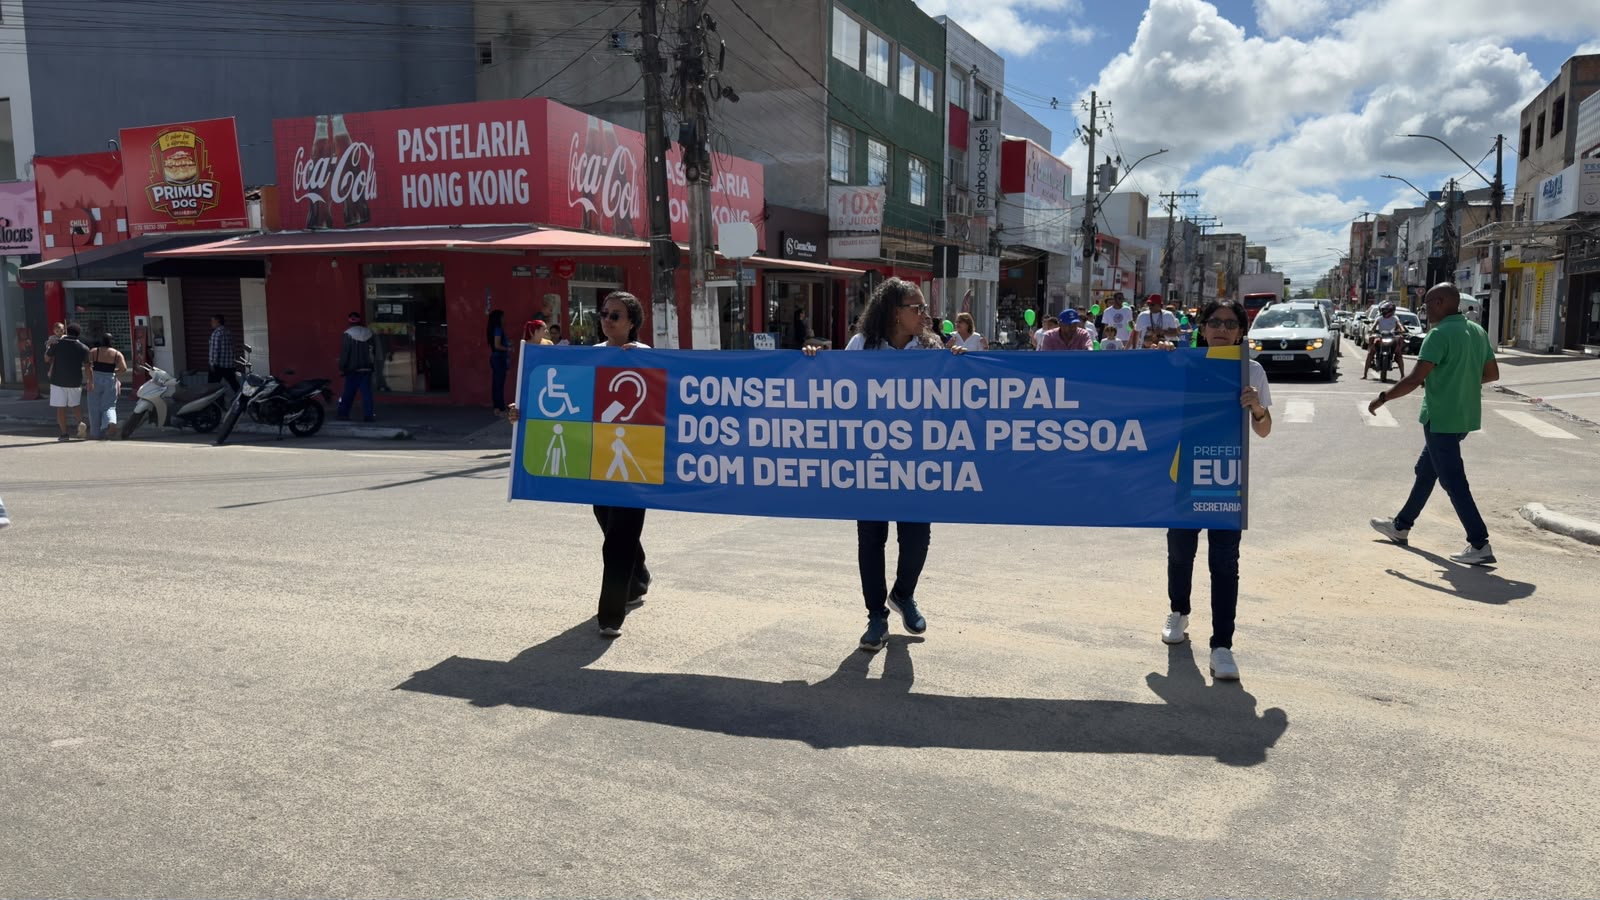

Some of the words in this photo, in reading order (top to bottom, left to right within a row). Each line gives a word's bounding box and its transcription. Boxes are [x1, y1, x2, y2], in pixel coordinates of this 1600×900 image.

[397, 119, 531, 164] PASTELARIA
[292, 141, 378, 204] Coca-Cola
[401, 171, 463, 209] HONG
[467, 168, 530, 207] KONG
[567, 131, 640, 220] Coca-Cola
[665, 160, 751, 199] ASARIA
[152, 181, 214, 203] PRIMUS
[172, 197, 197, 209] DOG
[838, 191, 880, 215] 10X
[69, 219, 89, 227] CHILLI
[848, 215, 879, 226] JUROS
[679, 375, 858, 410] CONSELHO
[867, 377, 1079, 410] MUNICIPAL
[677, 414, 741, 446] DOS
[748, 417, 913, 451] DIREITOS
[922, 419, 976, 451] DA
[986, 419, 1148, 452] PESSOA
[676, 452, 745, 485] COM
[753, 452, 984, 492] DEFICIÊNCIA
[1193, 502, 1242, 512] SECRETARIA
